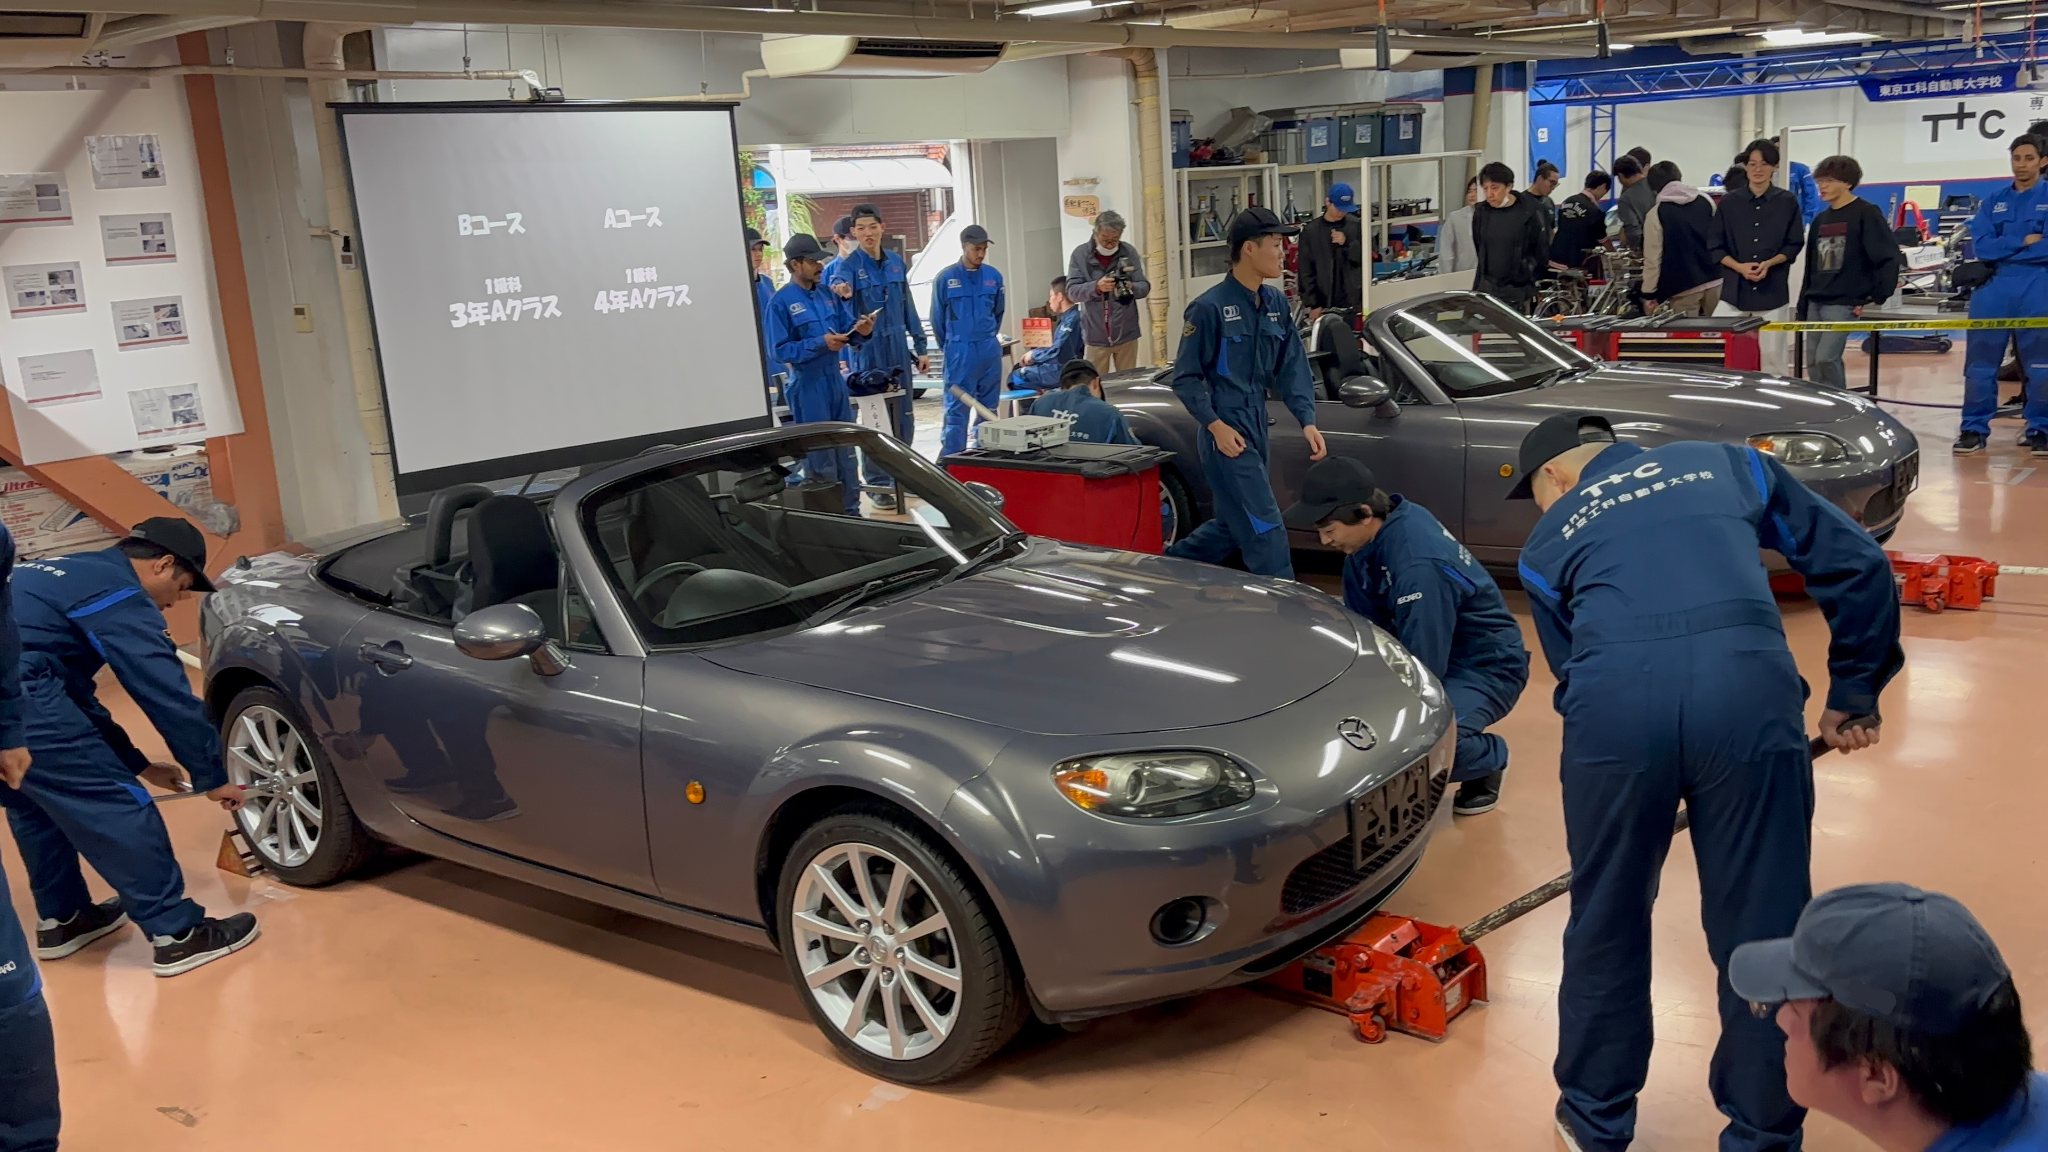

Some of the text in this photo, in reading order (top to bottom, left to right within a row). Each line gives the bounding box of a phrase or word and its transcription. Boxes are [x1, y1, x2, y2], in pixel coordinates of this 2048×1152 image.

[1878, 76, 2003, 97] 東京工科自動車大学校
[458, 212, 526, 236] Bコース
[604, 207, 663, 229] Aコース
[594, 284, 692, 314] 4年Aクラス
[449, 295, 562, 328] 3年Aクラス
